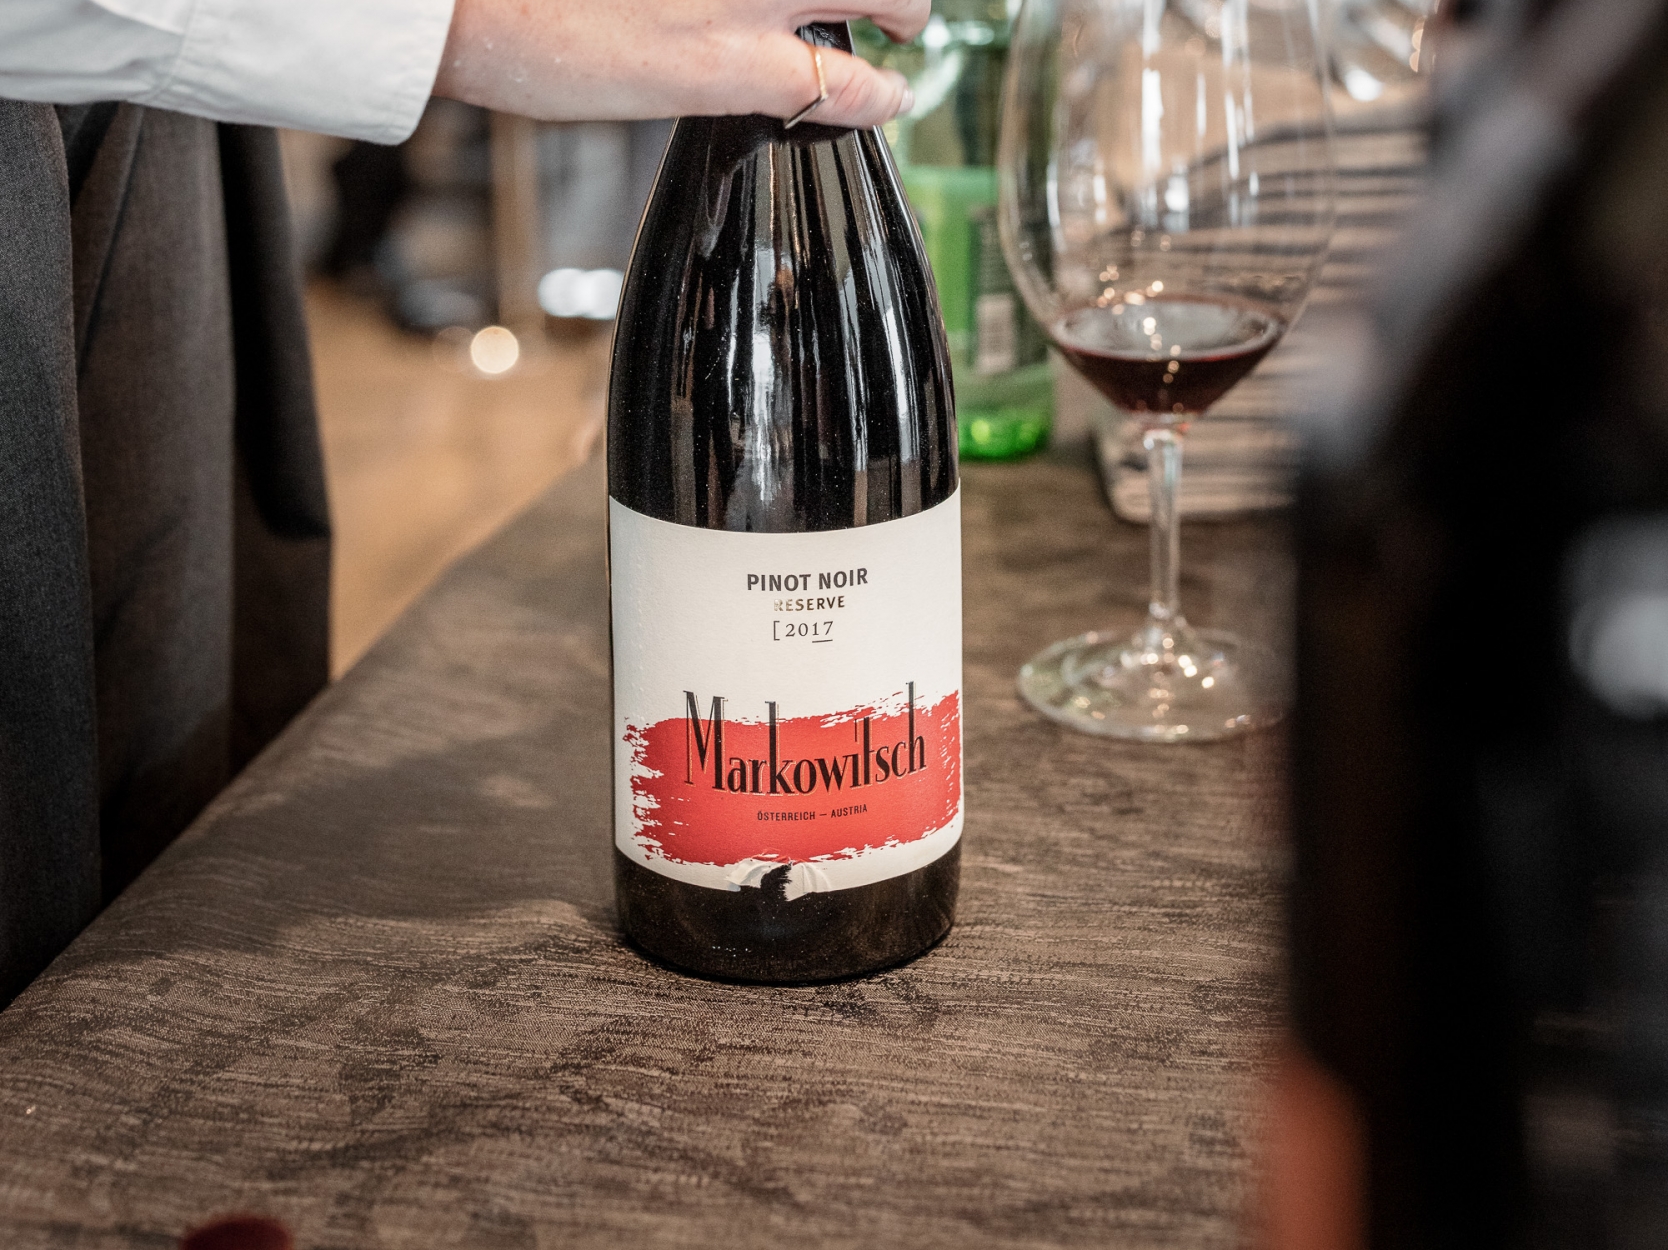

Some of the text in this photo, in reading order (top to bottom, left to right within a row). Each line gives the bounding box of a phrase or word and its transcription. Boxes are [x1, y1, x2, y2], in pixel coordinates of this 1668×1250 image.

[746, 567, 869, 592] PINOT NOIR
[773, 595, 846, 612] RESERVE
[683, 680, 927, 795] Markowitsch
[757, 810, 816, 822] ÖSTERREICH
[830, 803, 868, 819] AUSTRIA
